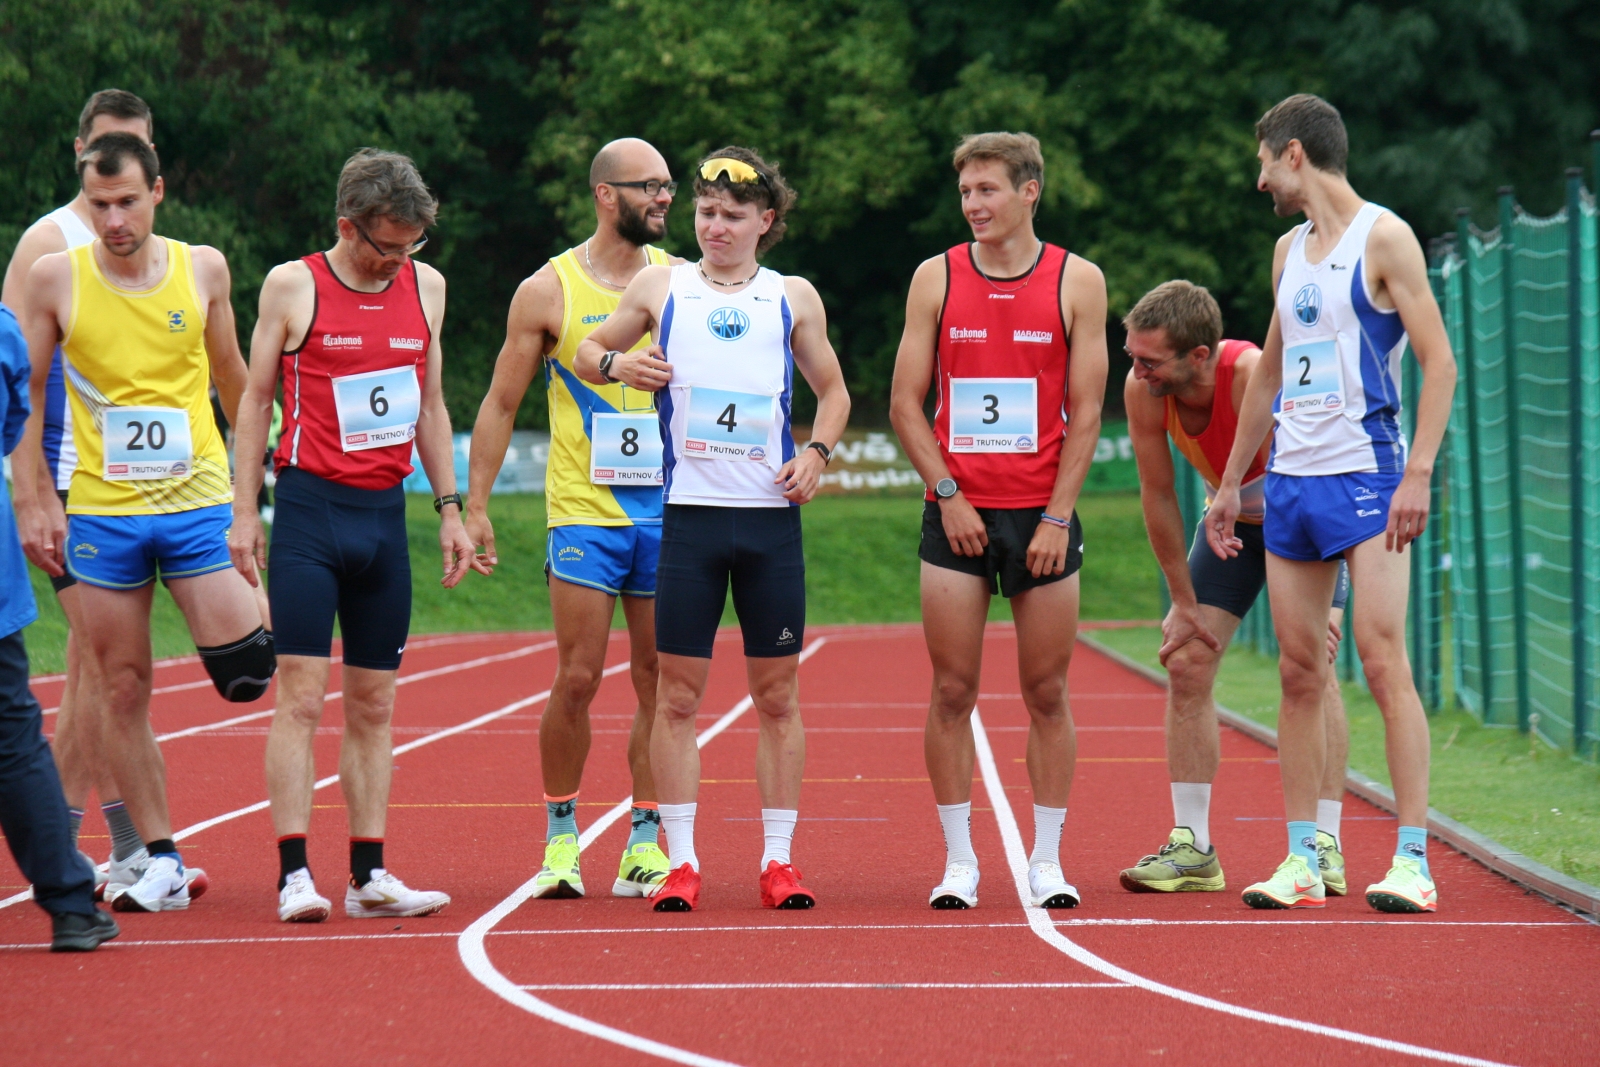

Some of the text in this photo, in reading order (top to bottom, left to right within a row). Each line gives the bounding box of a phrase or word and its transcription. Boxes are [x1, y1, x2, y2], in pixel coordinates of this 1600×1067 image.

[950, 327, 987, 339] Krakonoš
[1013, 330, 1053, 339] MARATON
[323, 334, 362, 346] Krakonoš
[389, 338, 424, 346] MARATON
[1298, 356, 1312, 386] 2
[369, 386, 389, 417] 6
[1295, 399, 1322, 408] TRUTNOV
[982, 394, 1000, 425] 3
[716, 403, 737, 433] 4
[126, 420, 166, 450] 20
[371, 430, 406, 441] TRUTNOV
[620, 427, 639, 457] 8
[709, 446, 746, 455] TRUTNOV
[558, 546, 585, 557] ATLETIKA
